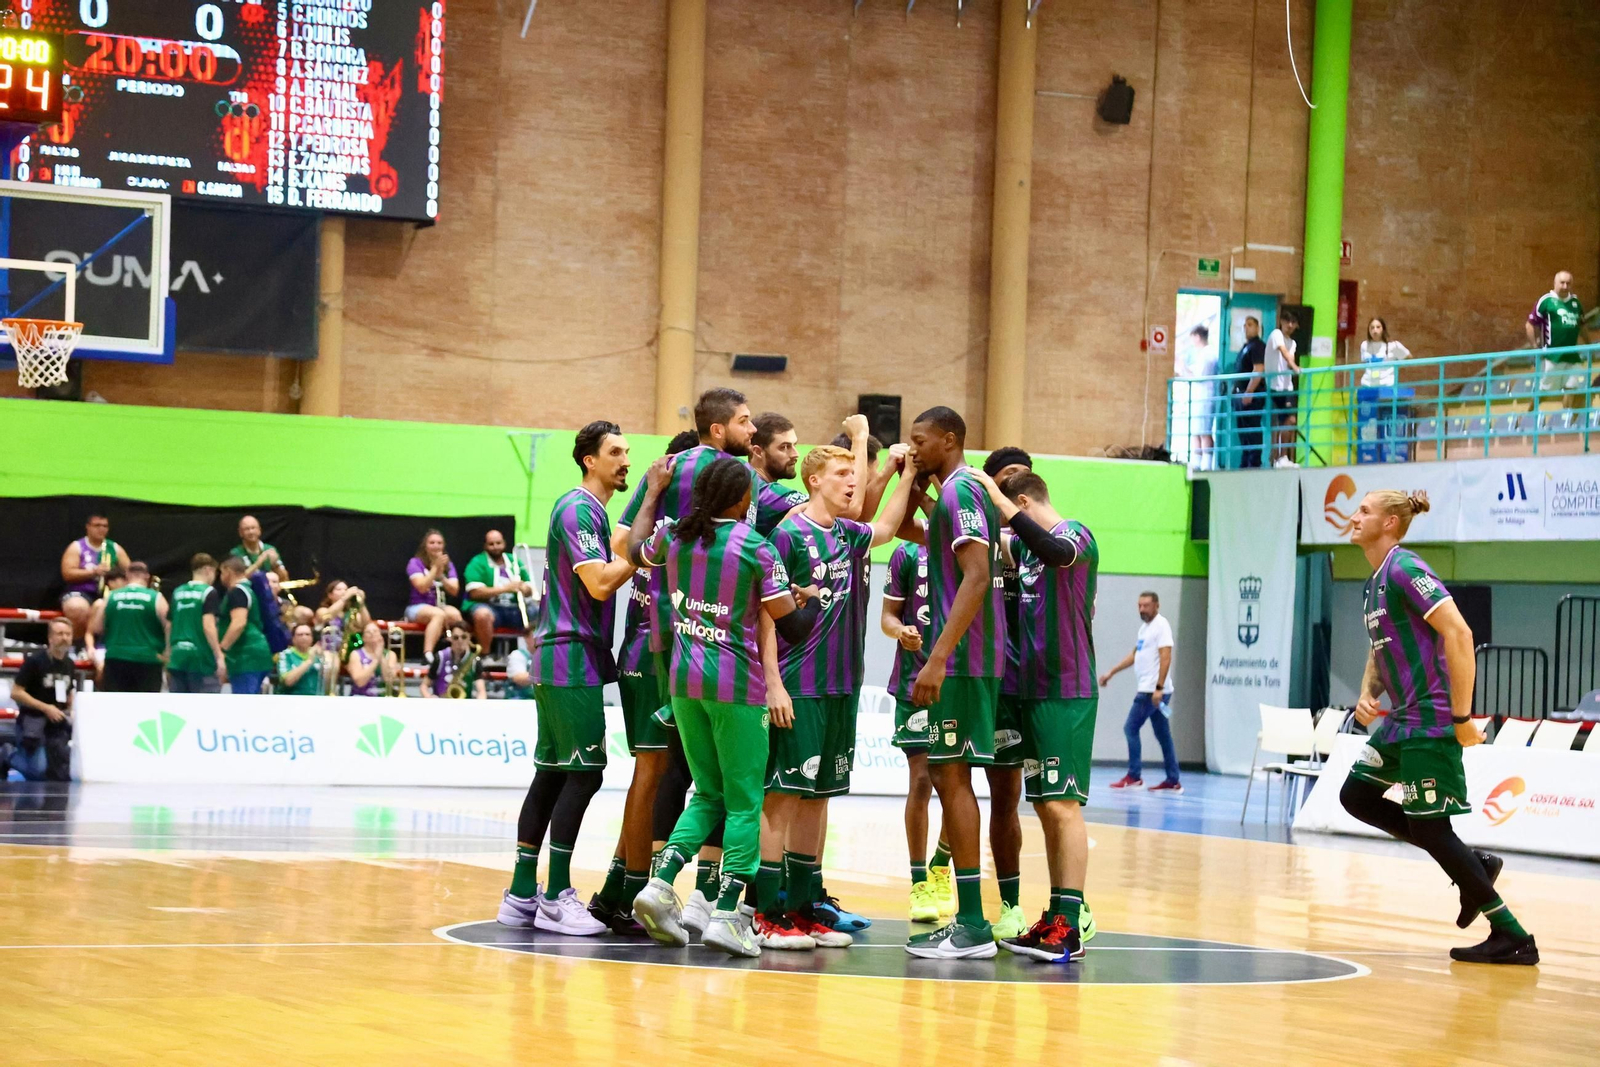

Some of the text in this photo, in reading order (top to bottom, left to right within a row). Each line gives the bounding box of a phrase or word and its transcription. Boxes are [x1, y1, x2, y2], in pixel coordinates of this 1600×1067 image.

[21, 11, 32, 30] 0
[79, 0, 109, 28] 0
[195, 3, 224, 41] 0
[277, 2, 442, 37] 5 C.HORNOS 0
[431, 2, 443, 20] 0
[0, 36, 50, 64] 0:00
[276, 21, 287, 39] 6
[431, 37, 442, 56] 0
[84, 34, 218, 81] 20:00
[277, 39, 287, 58] 7
[430, 55, 441, 73] 0
[116, 78, 185, 98] PERIODO
[276, 58, 286, 76] 8
[430, 74, 440, 92] 0
[275, 76, 286, 95] 9
[429, 91, 440, 109] 0
[268, 93, 286, 112] 10
[289, 96, 374, 121] C.BAUTISTA
[429, 109, 440, 128] 0
[269, 112, 285, 131] 11
[428, 127, 440, 145] 0
[268, 130, 285, 150] 12
[428, 145, 439, 164] 0
[267, 149, 285, 168] 13
[427, 163, 439, 181] 0
[267, 167, 284, 186] 14
[426, 181, 438, 200] 0
[266, 185, 284, 204] 15
[426, 199, 438, 218] 0
[1555, 478, 1599, 494] MÁLAGA
[685, 597, 729, 617] Unicaja
[196, 728, 315, 761] Unicaja
[414, 732, 527, 763] Unicaja
[855, 732, 891, 749] Fun
[857, 750, 906, 768] Unic
[1530, 793, 1595, 809] COSTA DEL SOL
